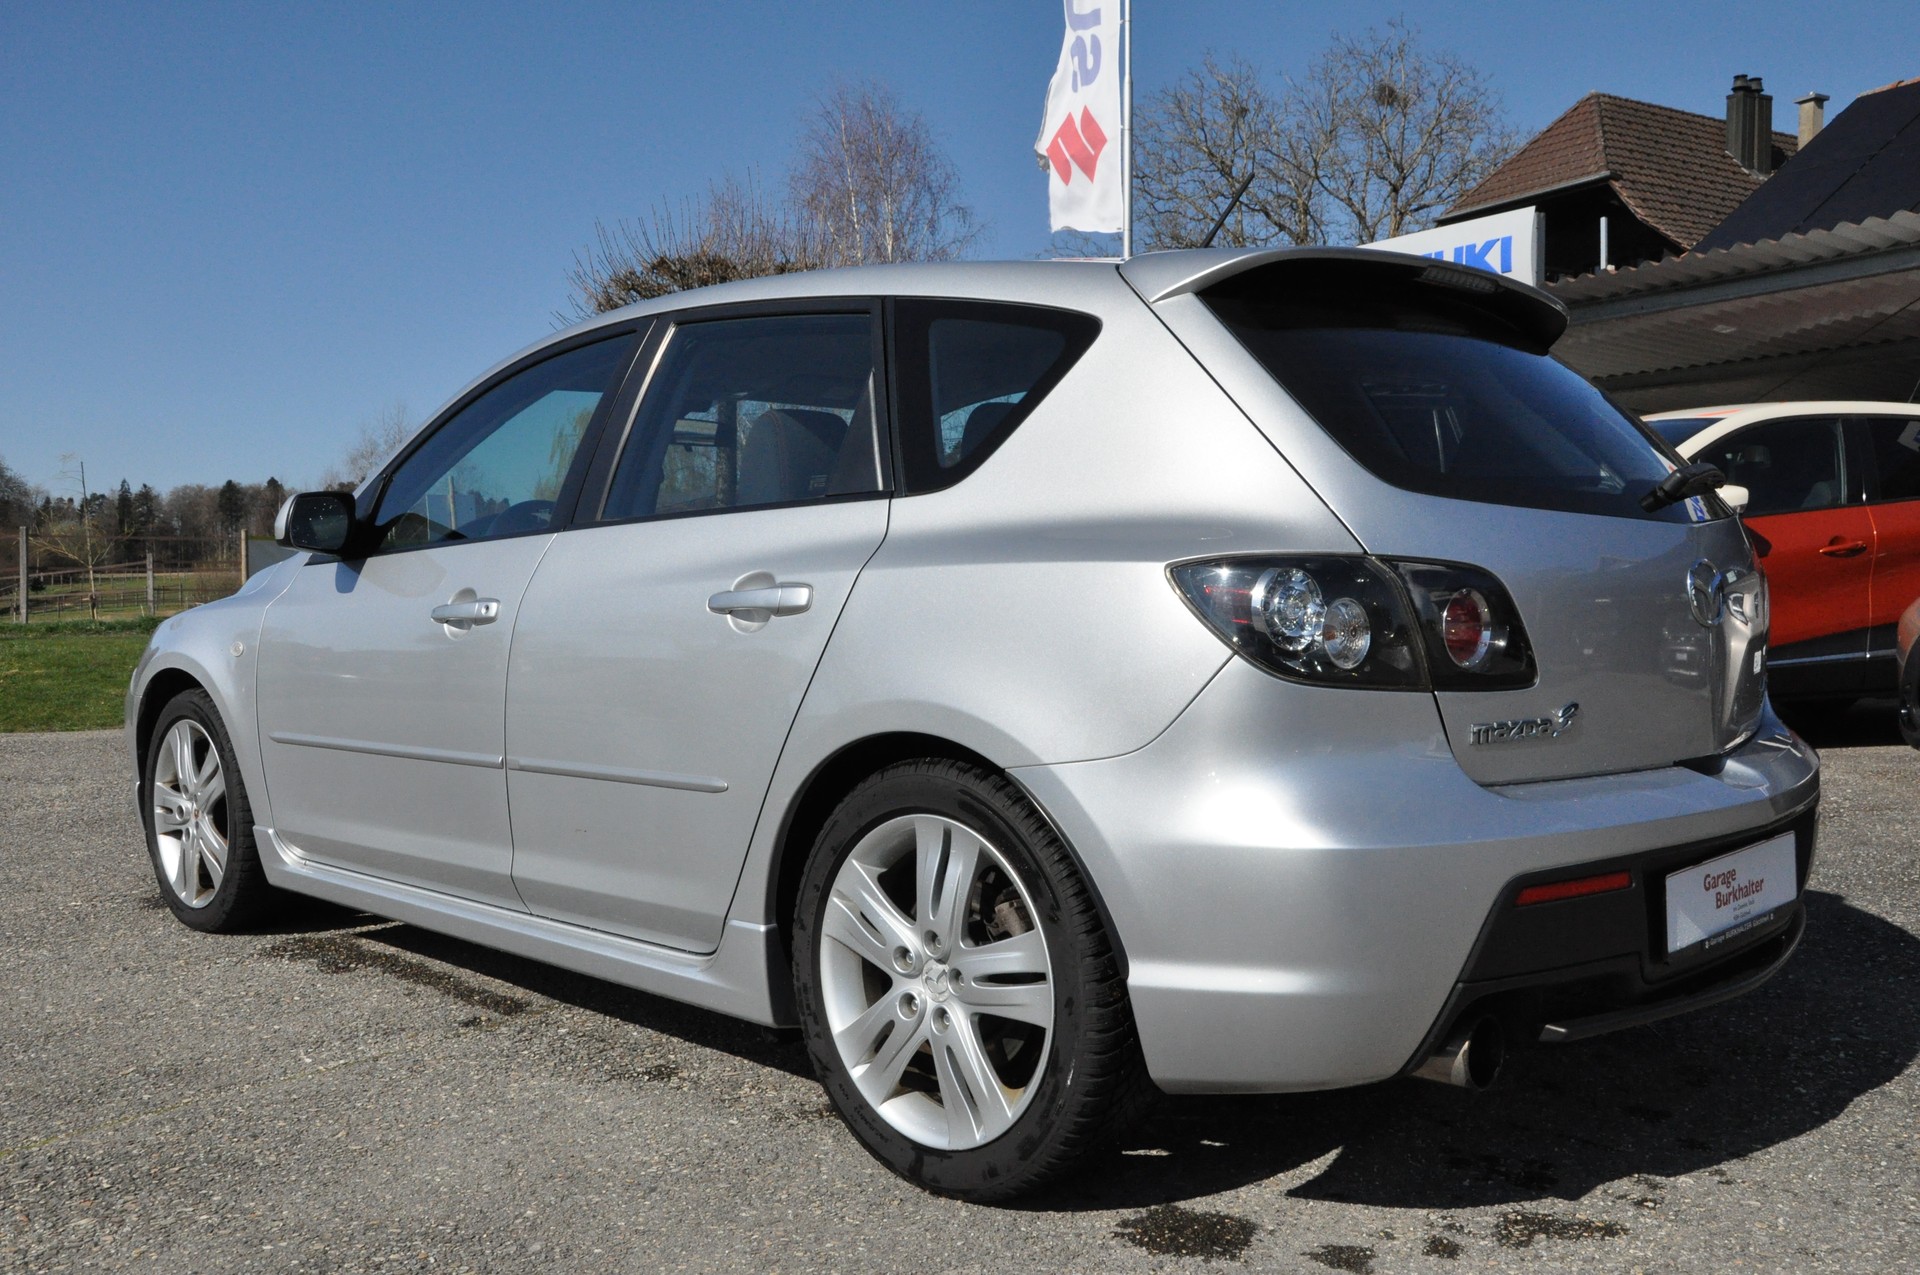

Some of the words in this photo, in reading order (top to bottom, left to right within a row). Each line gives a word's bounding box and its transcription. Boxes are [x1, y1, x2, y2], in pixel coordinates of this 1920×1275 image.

[1423, 235, 1512, 274] KI
[1703, 868, 1737, 891] Garage
[1715, 877, 1764, 909] Burkhalter
